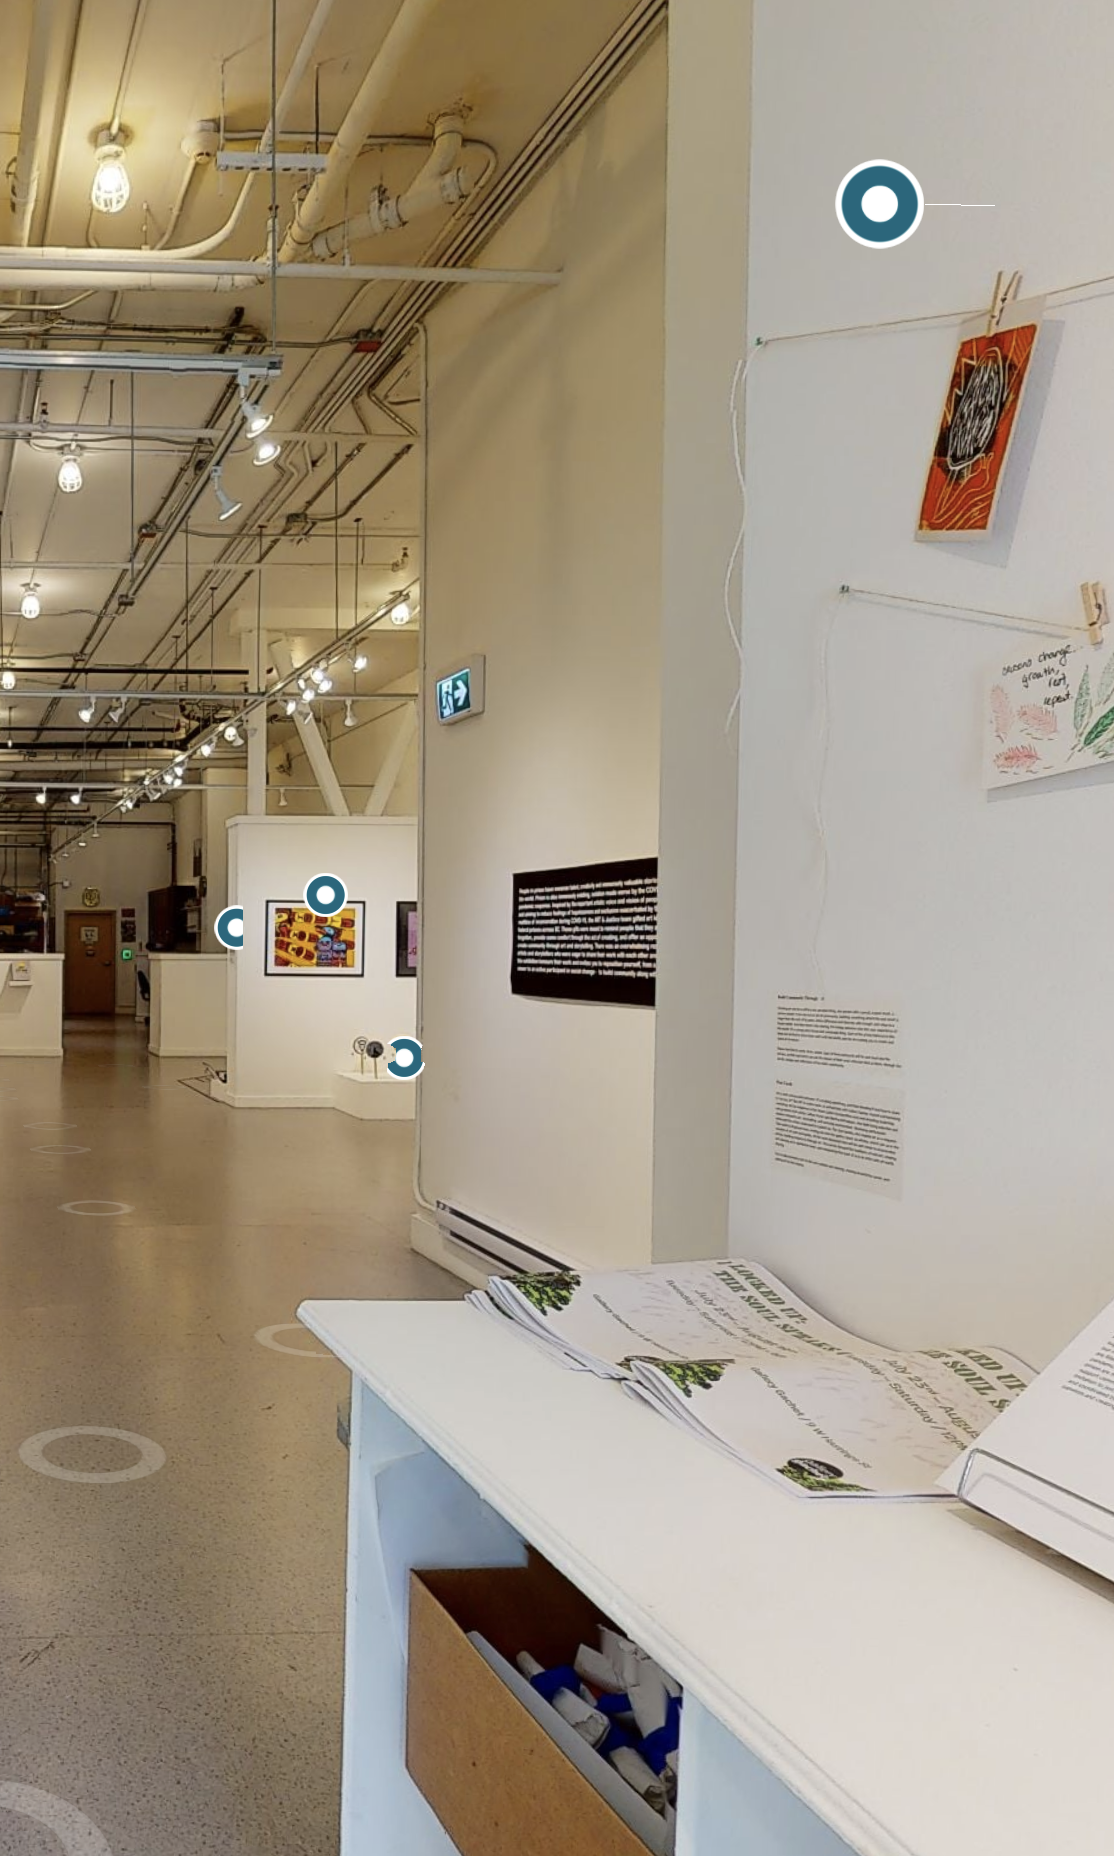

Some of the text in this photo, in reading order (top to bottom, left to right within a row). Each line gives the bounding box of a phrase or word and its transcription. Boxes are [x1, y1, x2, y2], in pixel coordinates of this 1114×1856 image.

[728, 1264, 786, 1305] LOCKED
[740, 1295, 781, 1322] SOUL
[942, 1360, 998, 1396] SOUL
[775, 1389, 805, 1416] Gachet
[888, 1382, 938, 1425] Saturday
